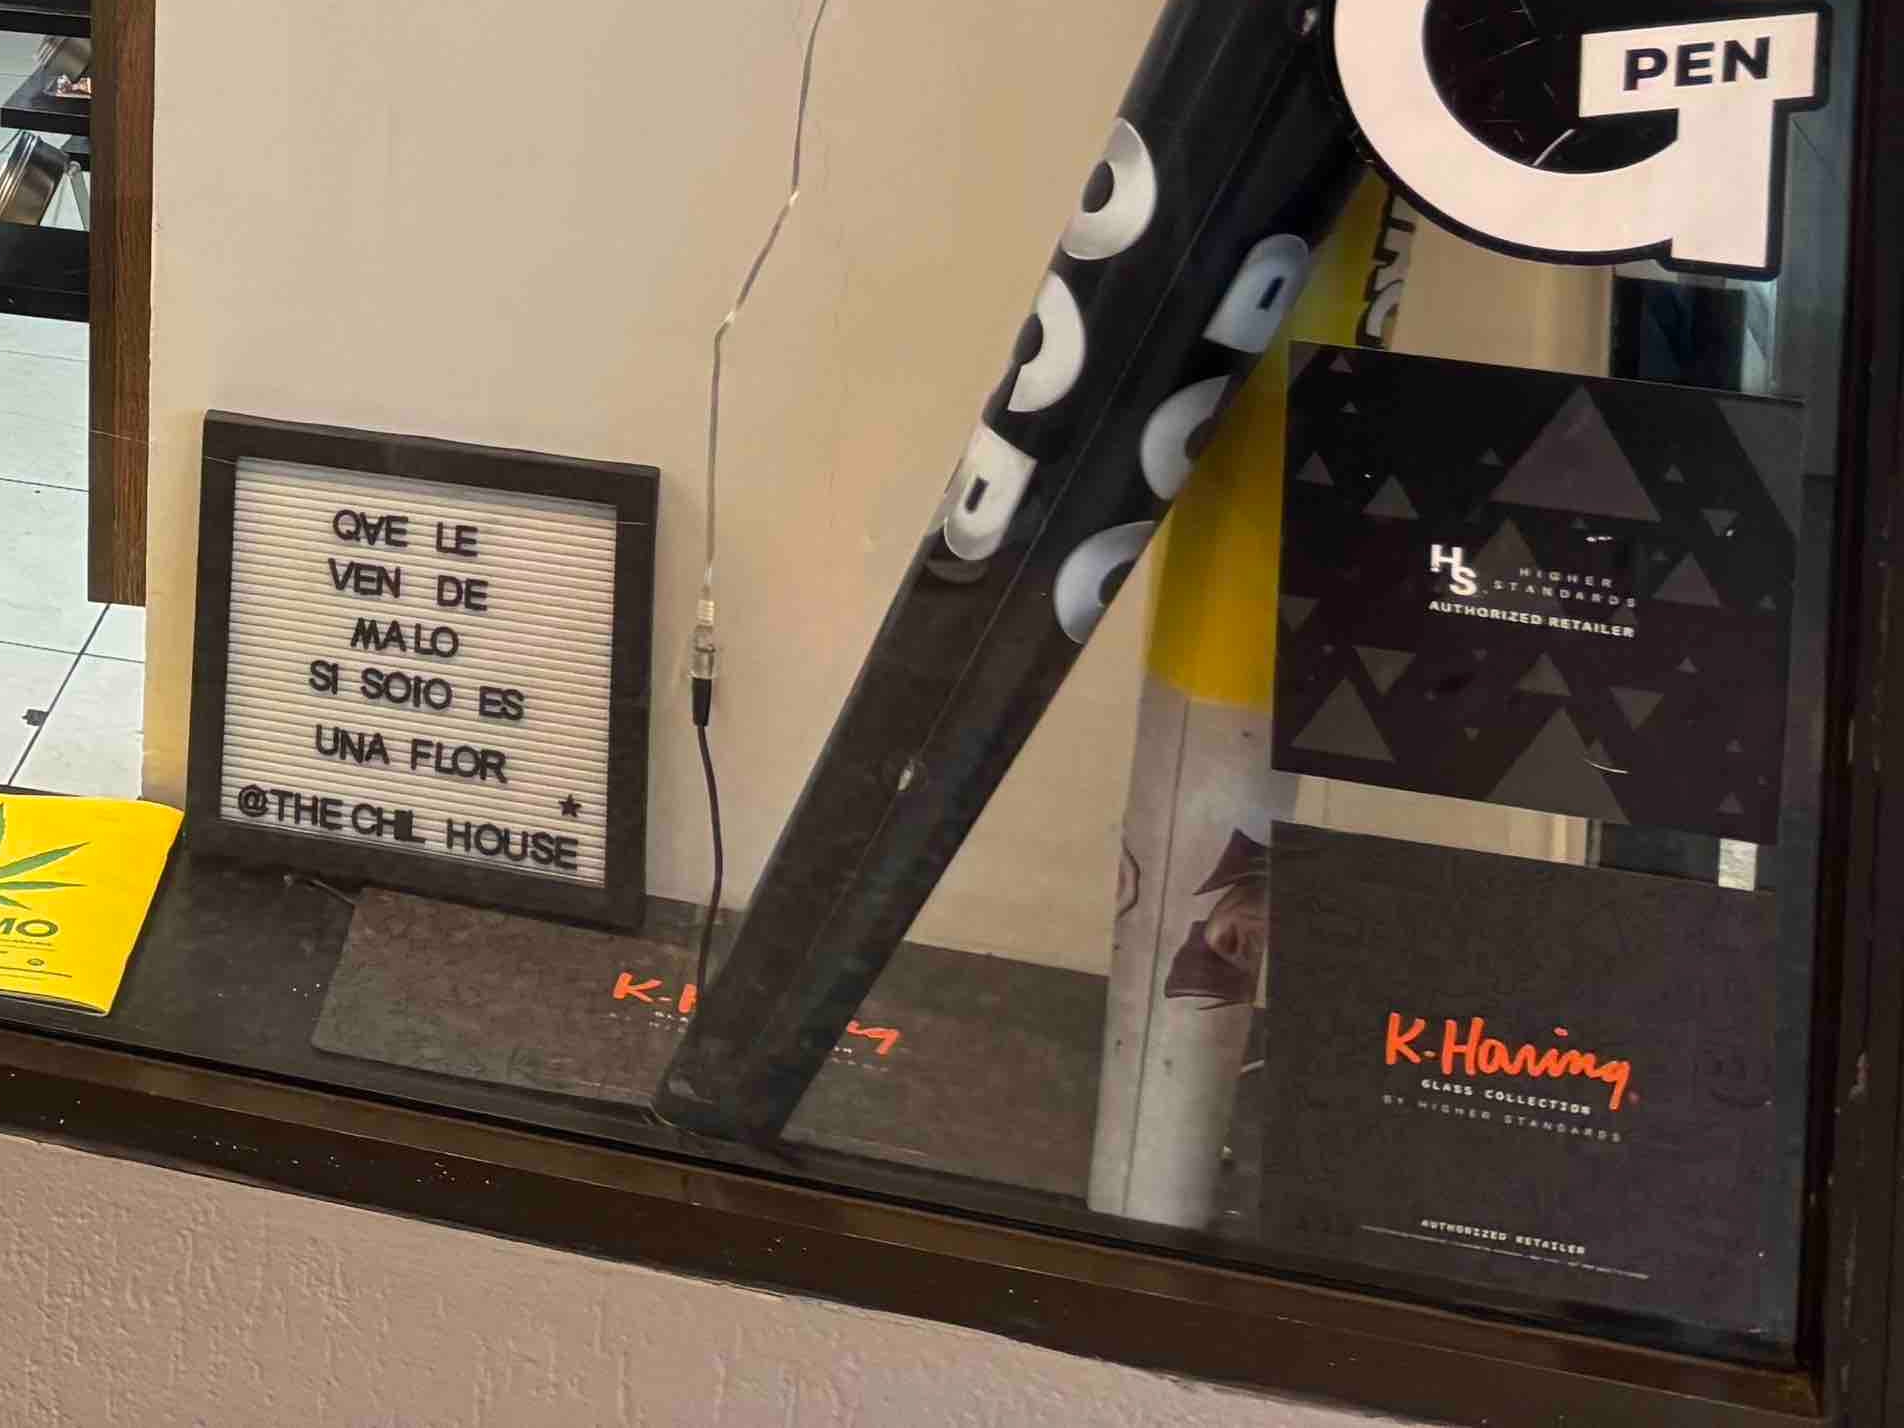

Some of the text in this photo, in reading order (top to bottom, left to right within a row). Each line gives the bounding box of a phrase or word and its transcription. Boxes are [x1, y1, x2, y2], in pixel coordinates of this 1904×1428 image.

[1624, 35, 1771, 92] PEN
[436, 521, 479, 557] LE
[327, 557, 489, 611] VEN DE
[1494, 577, 1638, 609] STANDARDS
[1518, 565, 1613, 589] HIGHER
[350, 617, 460, 659] MALO
[1429, 600, 1636, 640] AUTHORIZED RETAILER
[308, 659, 526, 722] SI ES
[313, 723, 508, 784] UNA FLOR
[446, 817, 580, 872] HOUSE
[1421, 1078, 1593, 1117] GLASS COLLECTION
[1421, 1218, 1587, 1255] AUTHORIZED RETAILER
